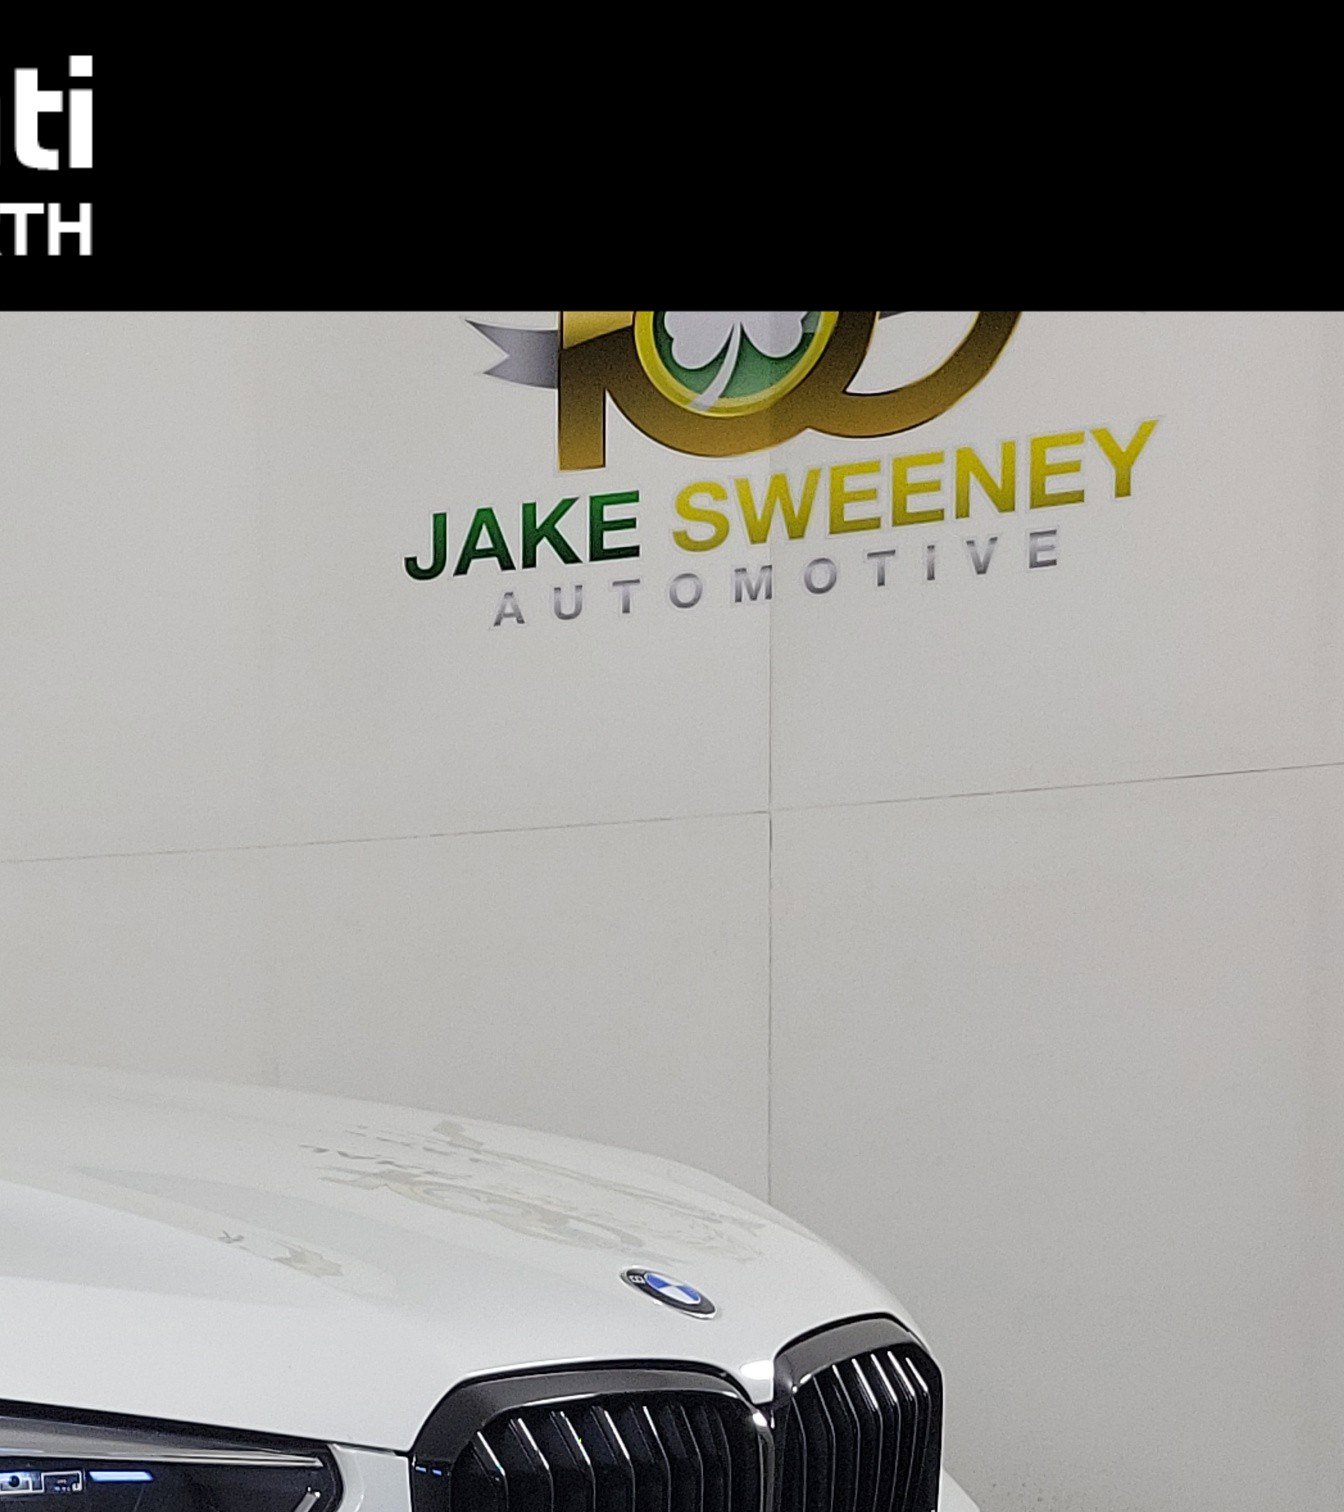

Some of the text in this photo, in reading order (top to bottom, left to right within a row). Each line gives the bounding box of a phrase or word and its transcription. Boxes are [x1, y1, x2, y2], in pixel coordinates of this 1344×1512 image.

[405, 419, 1158, 580] JAKE SWEENEY
[493, 530, 1058, 627] AUTOMOTIVE
